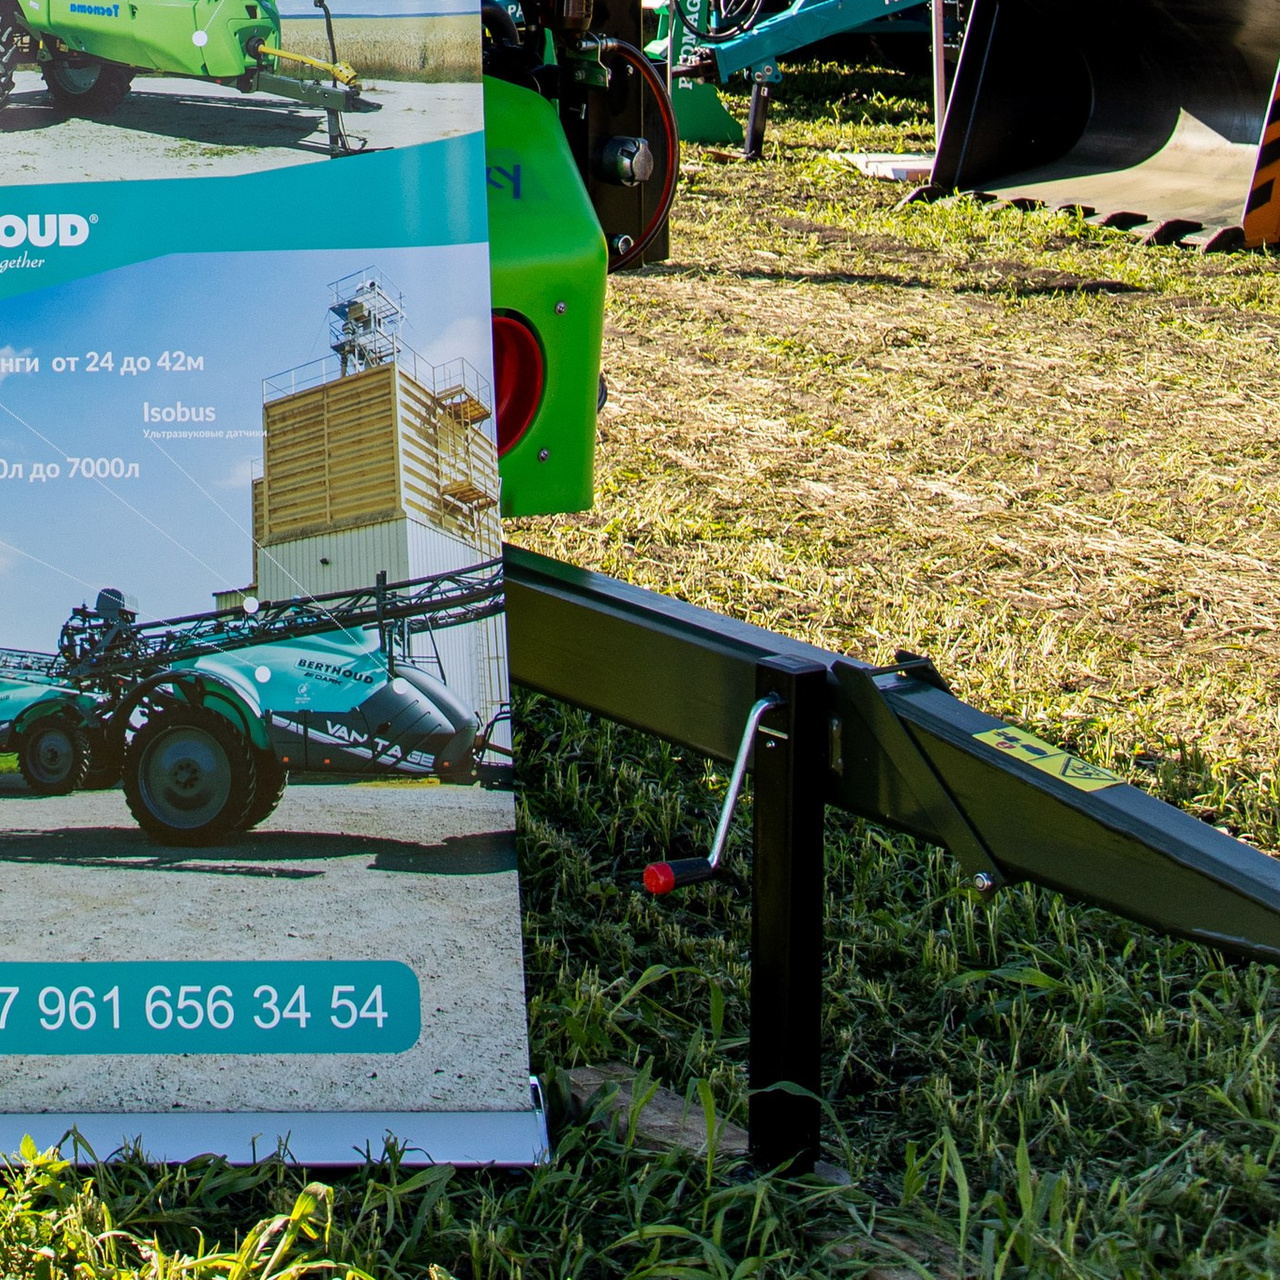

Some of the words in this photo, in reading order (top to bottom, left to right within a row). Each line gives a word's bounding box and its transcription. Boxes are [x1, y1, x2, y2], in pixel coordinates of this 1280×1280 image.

[52, 356, 79, 372] от
[85, 351, 114, 372] 24
[120, 355, 151, 376] до
[156, 350, 204, 372] 42м
[143, 401, 216, 422] Isobus
[143, 429, 224, 439] Ультразвуковые
[225, 429, 268, 439] датчики
[29, 463, 60, 483] до
[67, 457, 140, 479] 7000л
[298, 659, 374, 684] BERTHOUD
[38, 985, 122, 1030] 961
[145, 984, 235, 1028] 656
[253, 984, 311, 1028] 34
[330, 984, 388, 1028] 54
